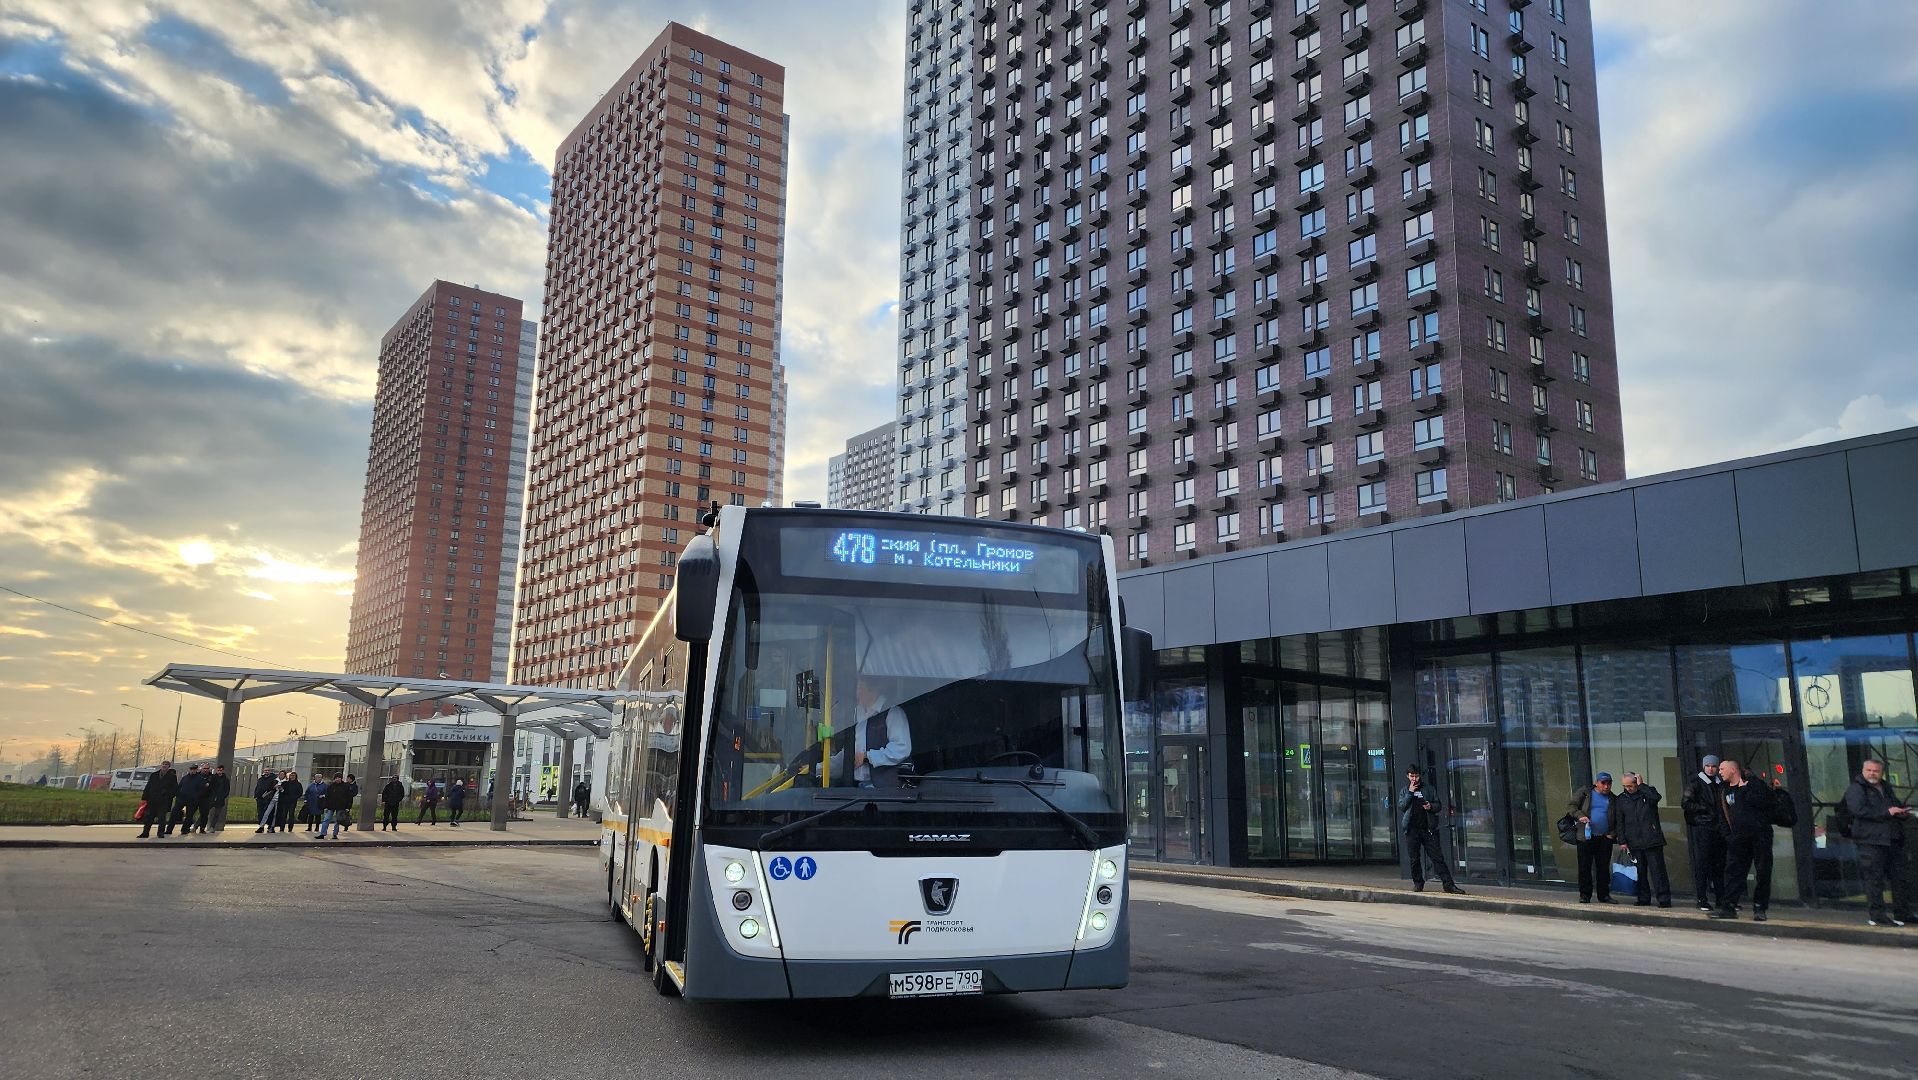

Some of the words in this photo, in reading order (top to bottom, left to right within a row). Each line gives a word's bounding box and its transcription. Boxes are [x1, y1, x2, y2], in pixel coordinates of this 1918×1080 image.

[833, 533, 875, 564] 478
[931, 539, 967, 555] (пл.
[977, 542, 1035, 560] Громов
[894, 553, 913, 565] м.
[923, 552, 1020, 572] Котельники
[424, 732, 490, 741] КОТЕЛЬНИКИ
[908, 834, 970, 842] KAMAZ
[956, 971, 979, 985] 790
